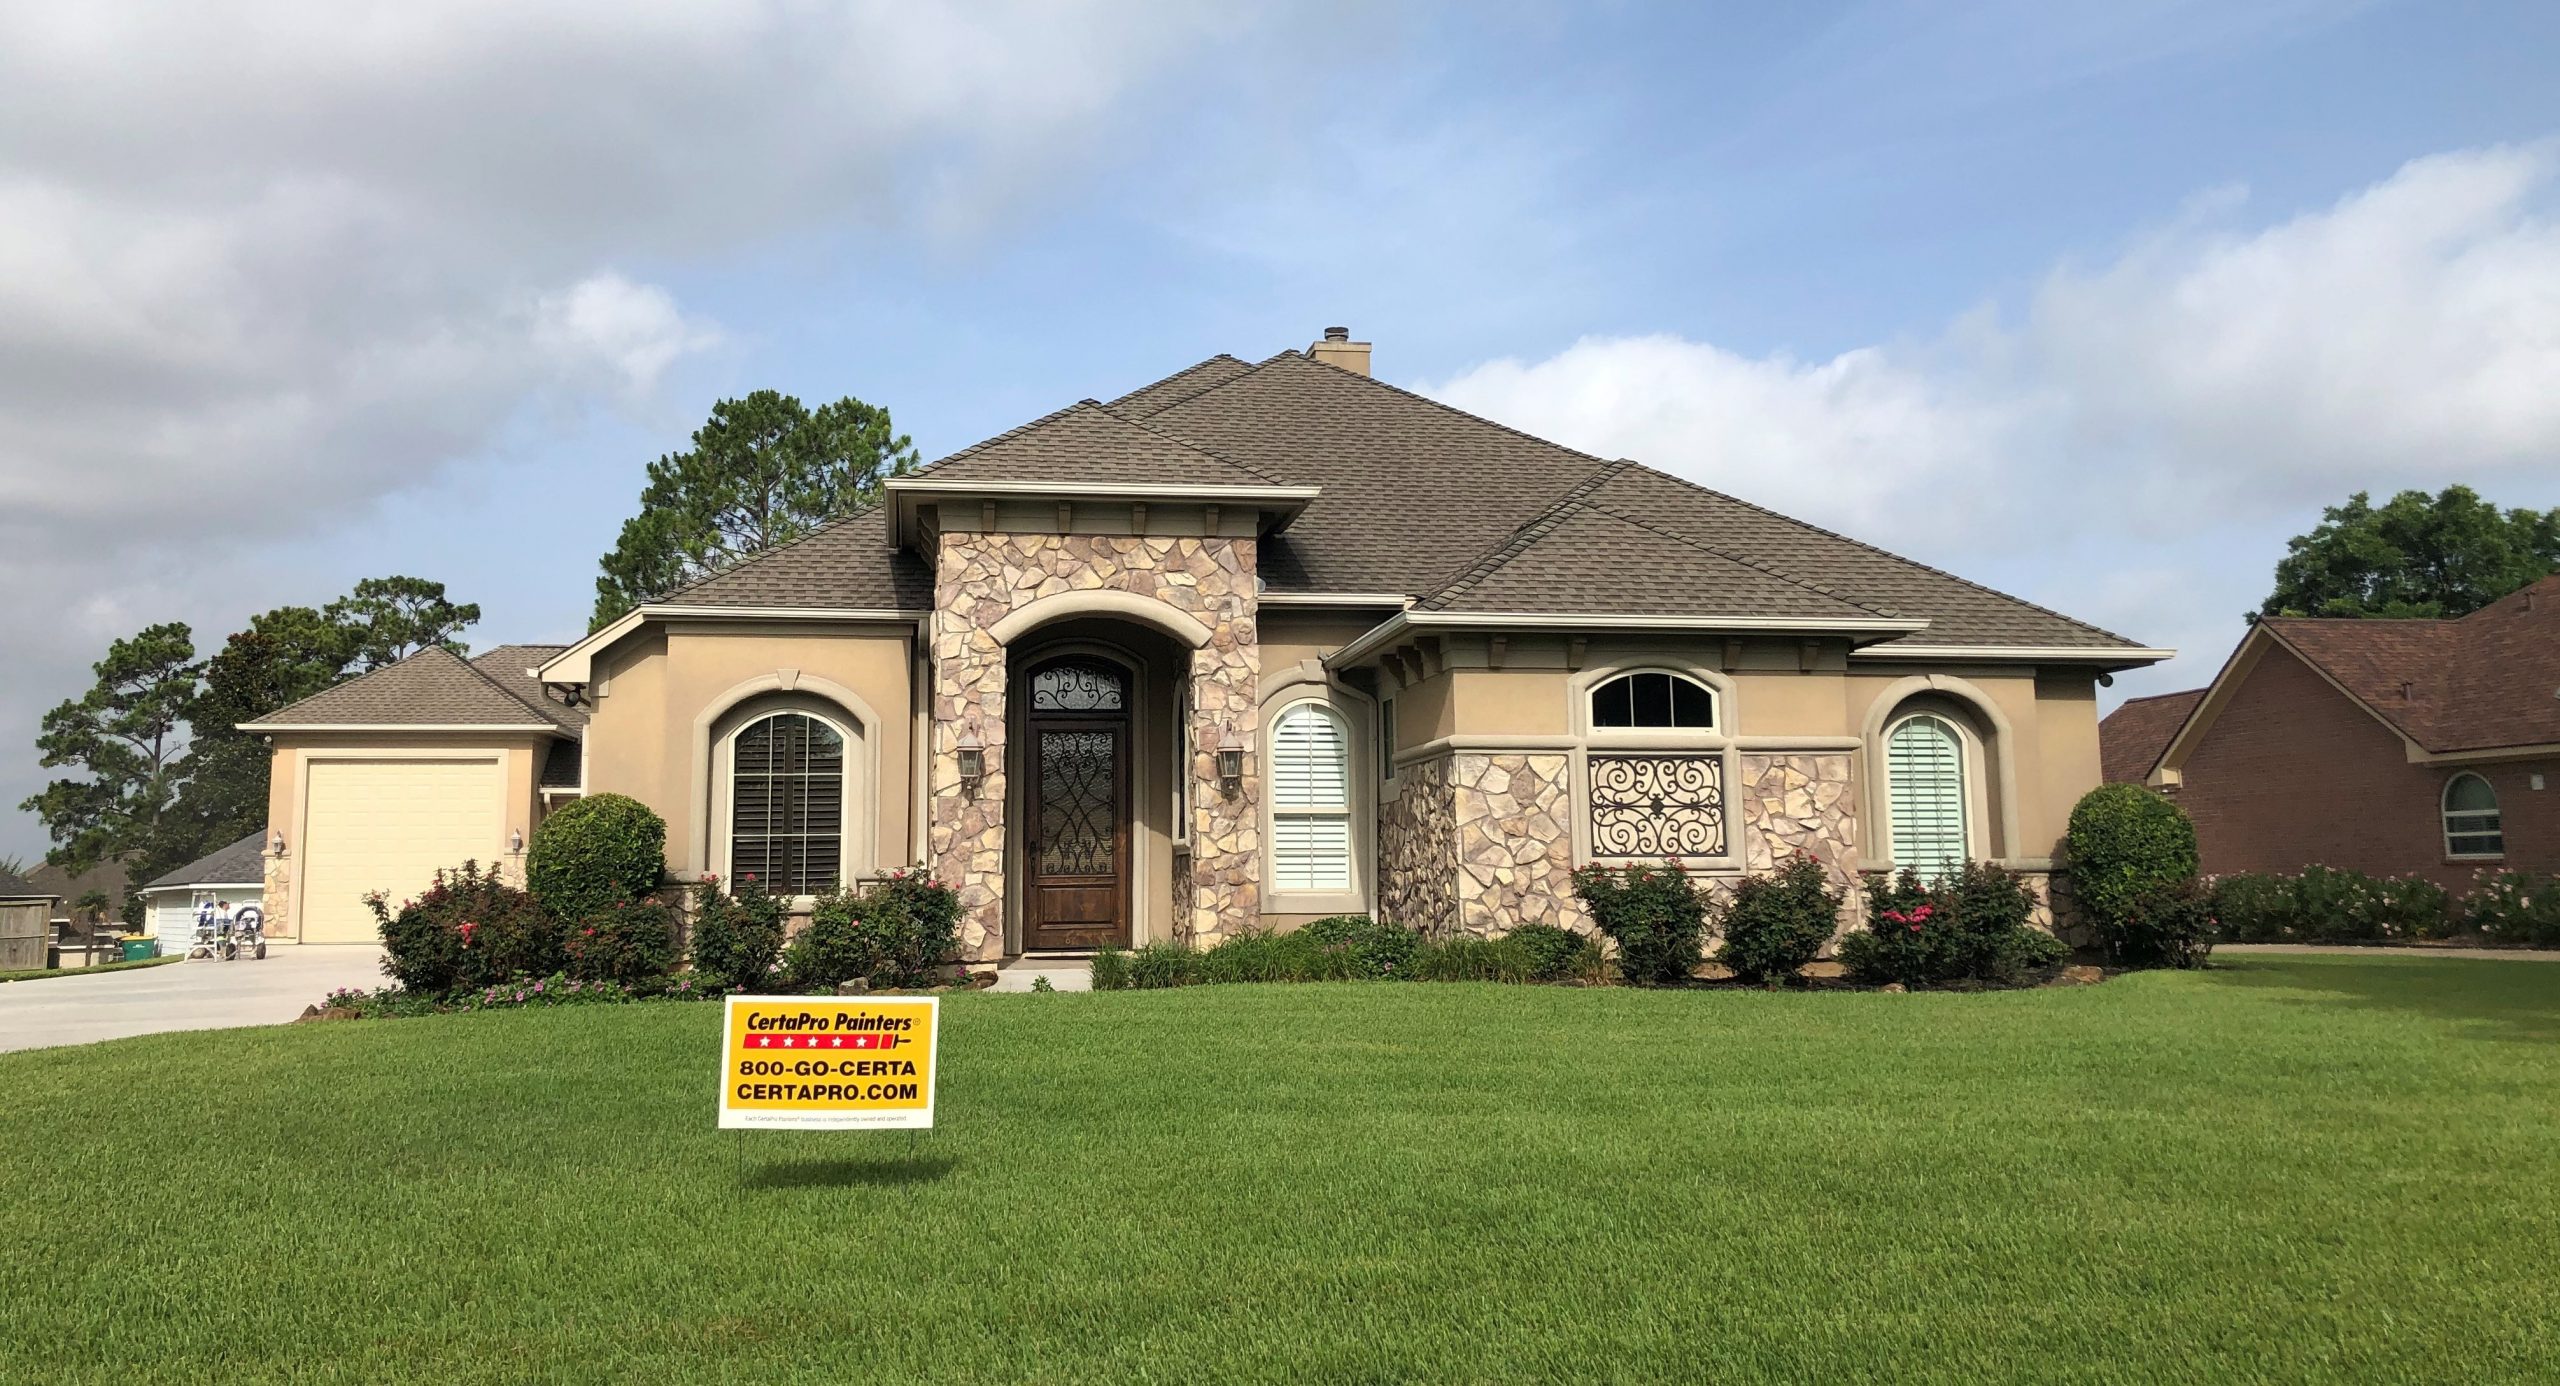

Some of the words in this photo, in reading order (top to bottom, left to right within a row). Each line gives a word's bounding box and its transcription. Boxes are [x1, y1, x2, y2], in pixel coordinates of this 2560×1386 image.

[747, 1012, 829, 1031] CertaPro
[739, 1061, 917, 1076] 800-GO-CERTA
[737, 1083, 918, 1101] CERTAPRO.COM
